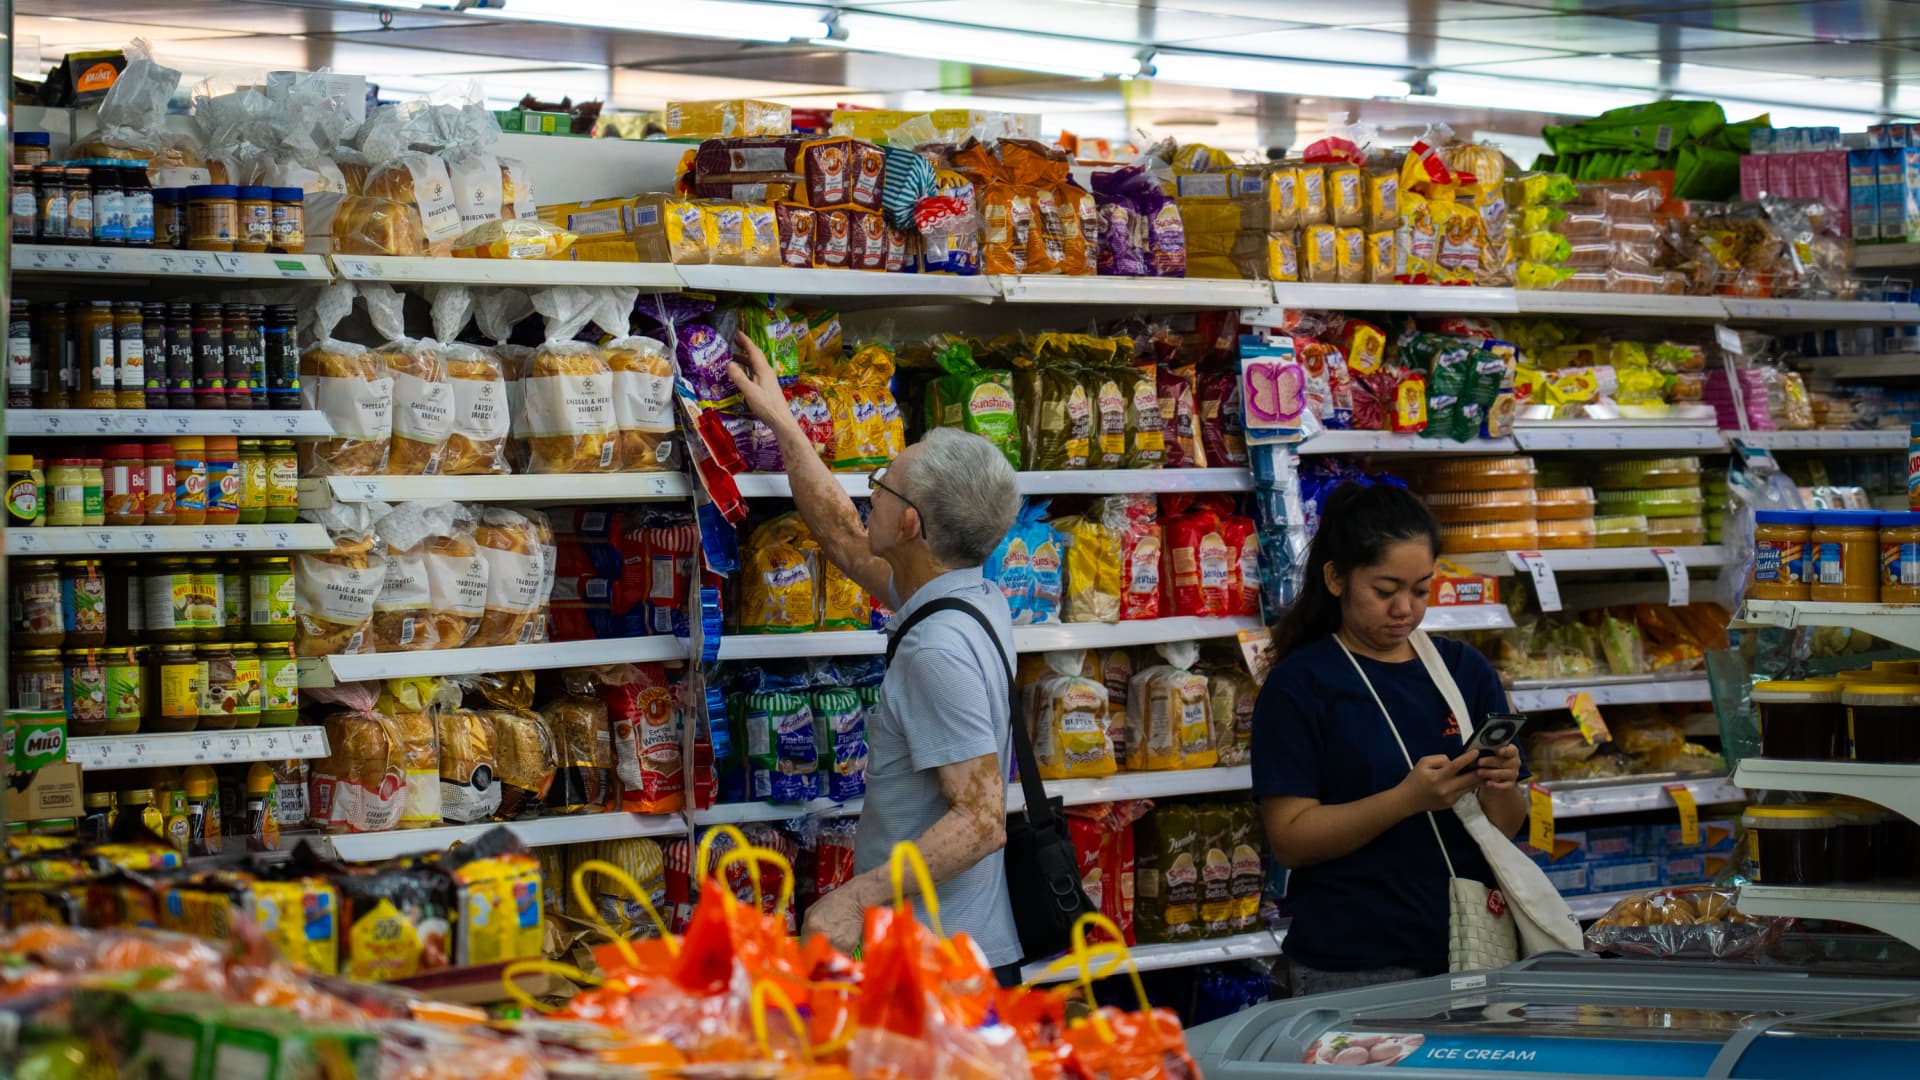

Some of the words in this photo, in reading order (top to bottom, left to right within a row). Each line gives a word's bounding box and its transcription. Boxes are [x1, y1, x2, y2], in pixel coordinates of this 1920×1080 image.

[578, 405, 602, 413] BRIOCHE
[970, 396, 1012, 411] Sunshine
[327, 583, 349, 594] GARLIC
[338, 593, 364, 603] BRIOCHE
[28, 734, 61, 753] MILO
[1427, 1048, 1461, 1059] ICE
[1463, 1048, 1537, 1061] CREAM
